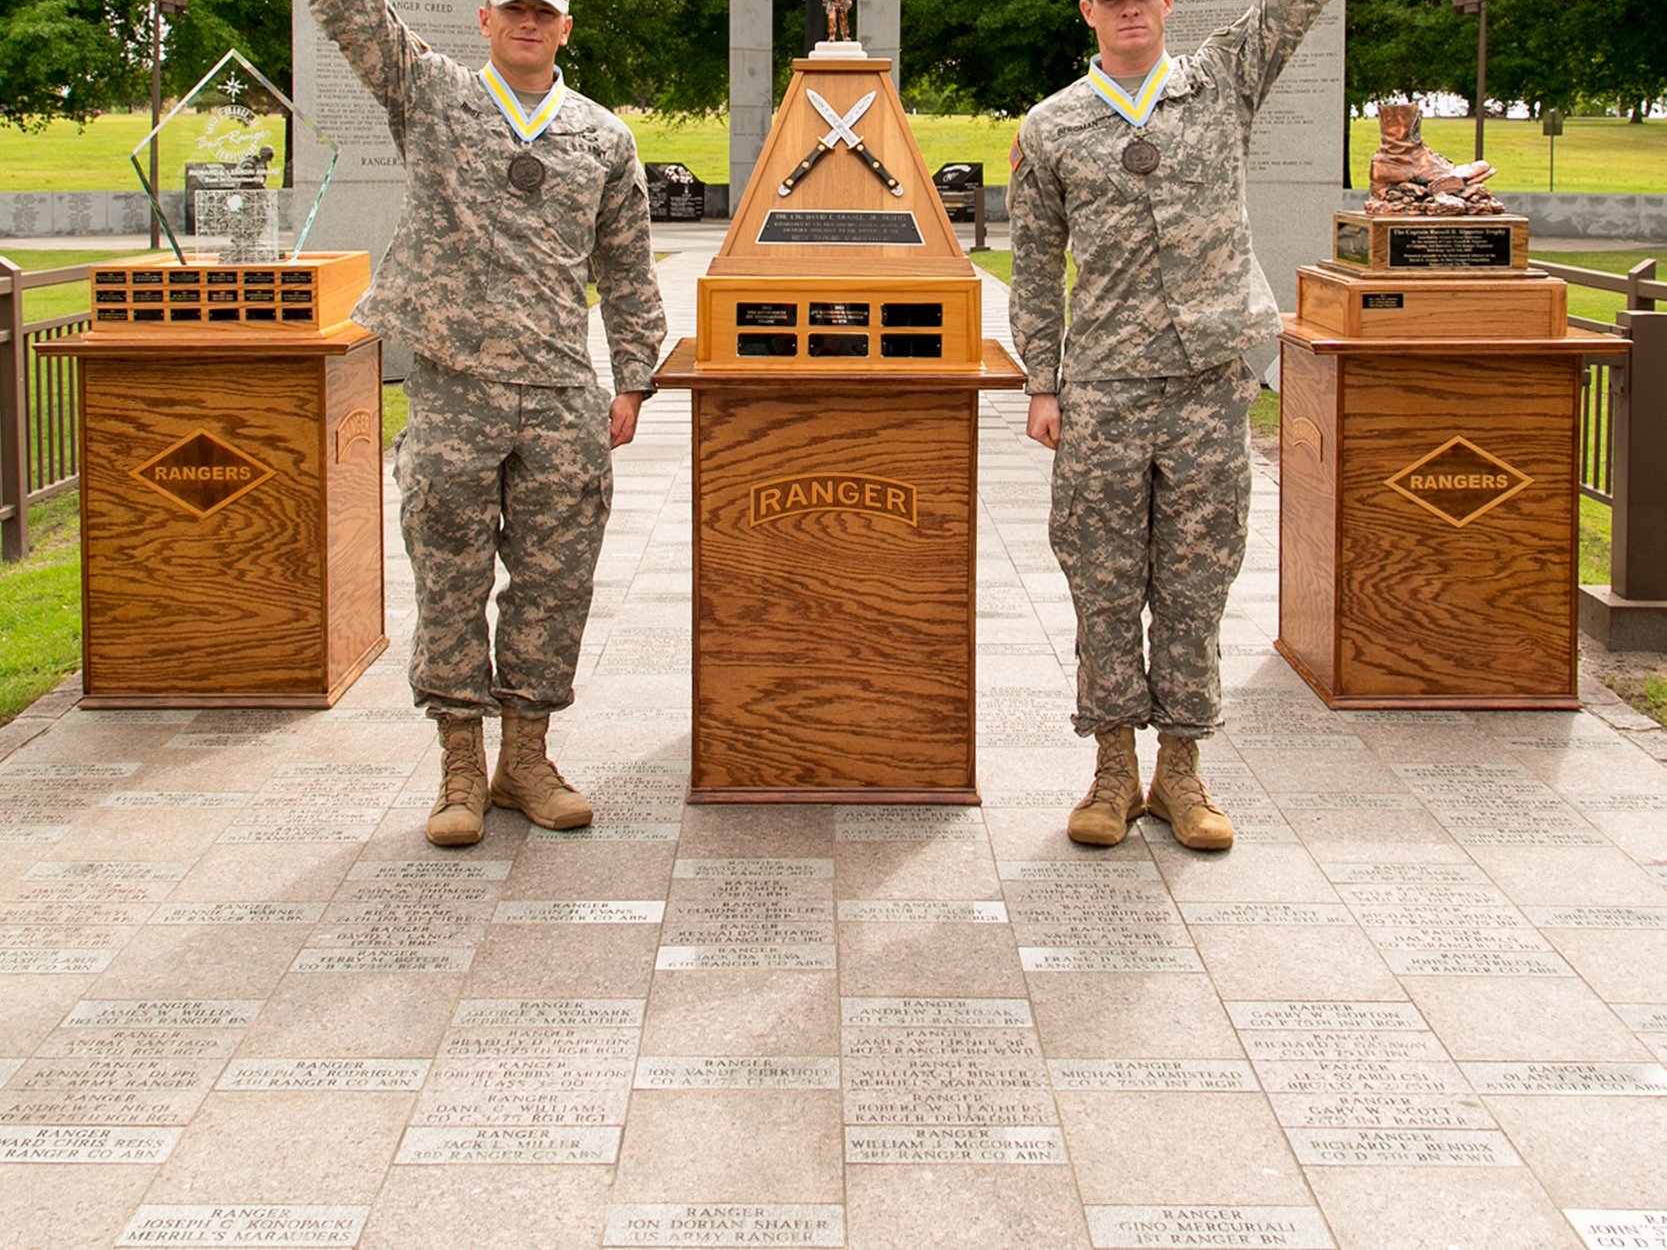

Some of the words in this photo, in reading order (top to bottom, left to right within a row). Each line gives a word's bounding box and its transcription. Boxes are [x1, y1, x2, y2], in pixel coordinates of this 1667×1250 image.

[384, 2, 420, 13] ANGER
[425, 3, 453, 13] CREED
[155, 466, 251, 480] RANGERS
[1410, 474, 1509, 489] RANGERS
[760, 481, 907, 515] RANGER
[519, 1001, 584, 1009] RANGER
[903, 1000, 966, 1008] RANGER
[1288, 1004, 1353, 1012] RANGER
[295, 1061, 365, 1069] RANGER
[705, 1059, 772, 1067] RANGER
[1114, 1062, 1183, 1070] RANGER
[268, 1078, 338, 1087] RANGER
[1068, 1080, 1091, 1088] CO
[1339, 1096, 1412, 1105] RANGER
[36, 1129, 112, 1138] RANGER
[476, 1130, 550, 1139] RANGER
[916, 1129, 990, 1138] RANGER
[1359, 1132, 1434, 1142] RANGER
[851, 1139, 924, 1149] WILLIAM
[4, 1149, 80, 1158] RANGER
[87, 1149, 113, 1158] CO
[449, 1150, 523, 1160] RANGER
[532, 1150, 558, 1160] CO
[898, 1150, 972, 1160] RANGER
[981, 1150, 1006, 1160] CO
[1015, 1150, 1052, 1160] ABN
[211, 1208, 290, 1218] RANGER
[686, 1207, 766, 1217] RANGER
[1162, 1210, 1243, 1220] RANGER
[137, 1219, 212, 1229] JOSEPH
[669, 1219, 744, 1230] DORIAN
[1119, 1221, 1168, 1232] GINO
[234, 1230, 352, 1241] MARAUDERS
[671, 1232, 724, 1242] ARMY
[734, 1232, 814, 1242] RANGER
[1170, 1234, 1249, 1244] RANGER
[1260, 1234, 1287, 1244] BN
[1597, 1237, 1626, 1248] CO
[1633, 1237, 1649, 1248] D
